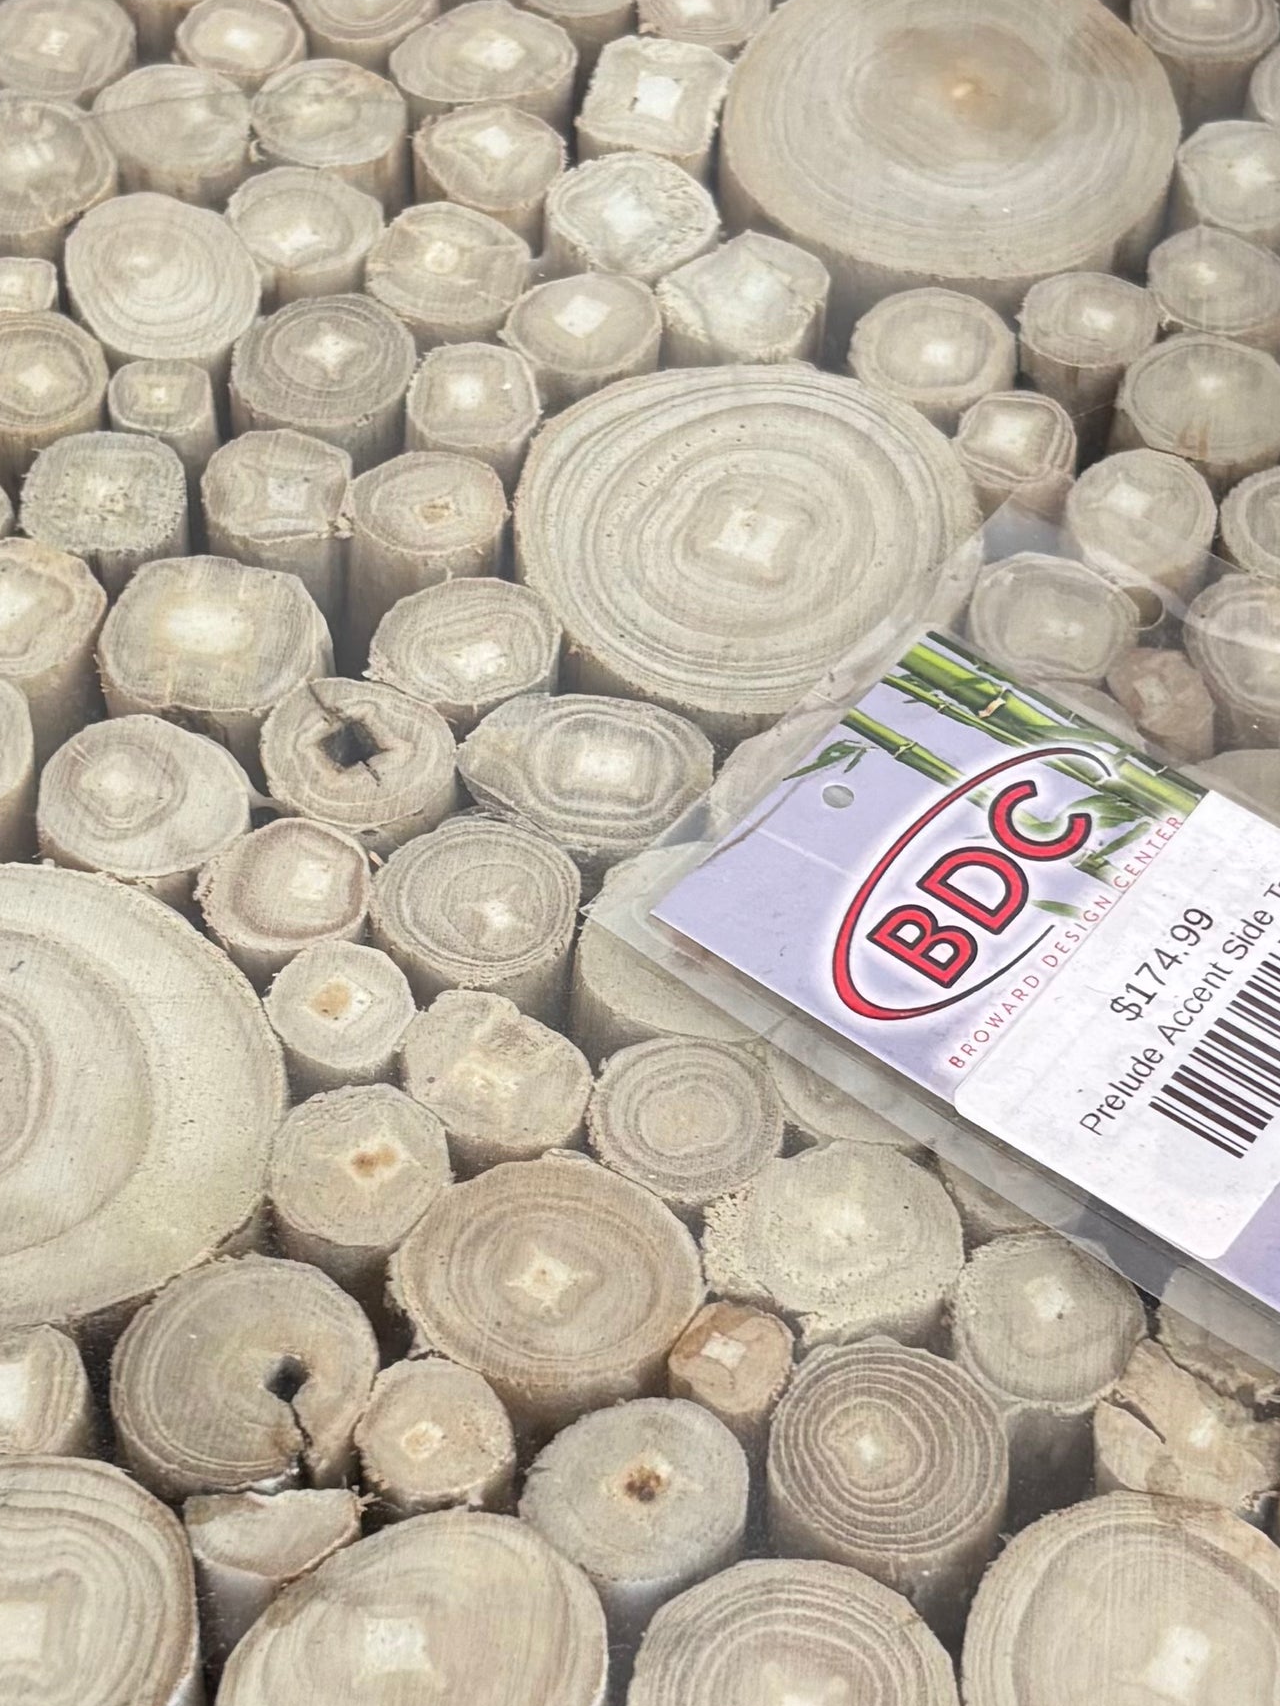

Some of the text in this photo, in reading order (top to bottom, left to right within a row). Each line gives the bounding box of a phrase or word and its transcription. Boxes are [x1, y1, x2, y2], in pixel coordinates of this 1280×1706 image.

[866, 779, 1093, 989] BDC
[948, 816, 1184, 1069] BROWARD DESIGN CENTER
[1109, 907, 1214, 1021] $174.99
[1079, 1047, 1164, 1136] Prelude
[1157, 961, 1233, 1046] Accent
[1222, 909, 1274, 960] Side
